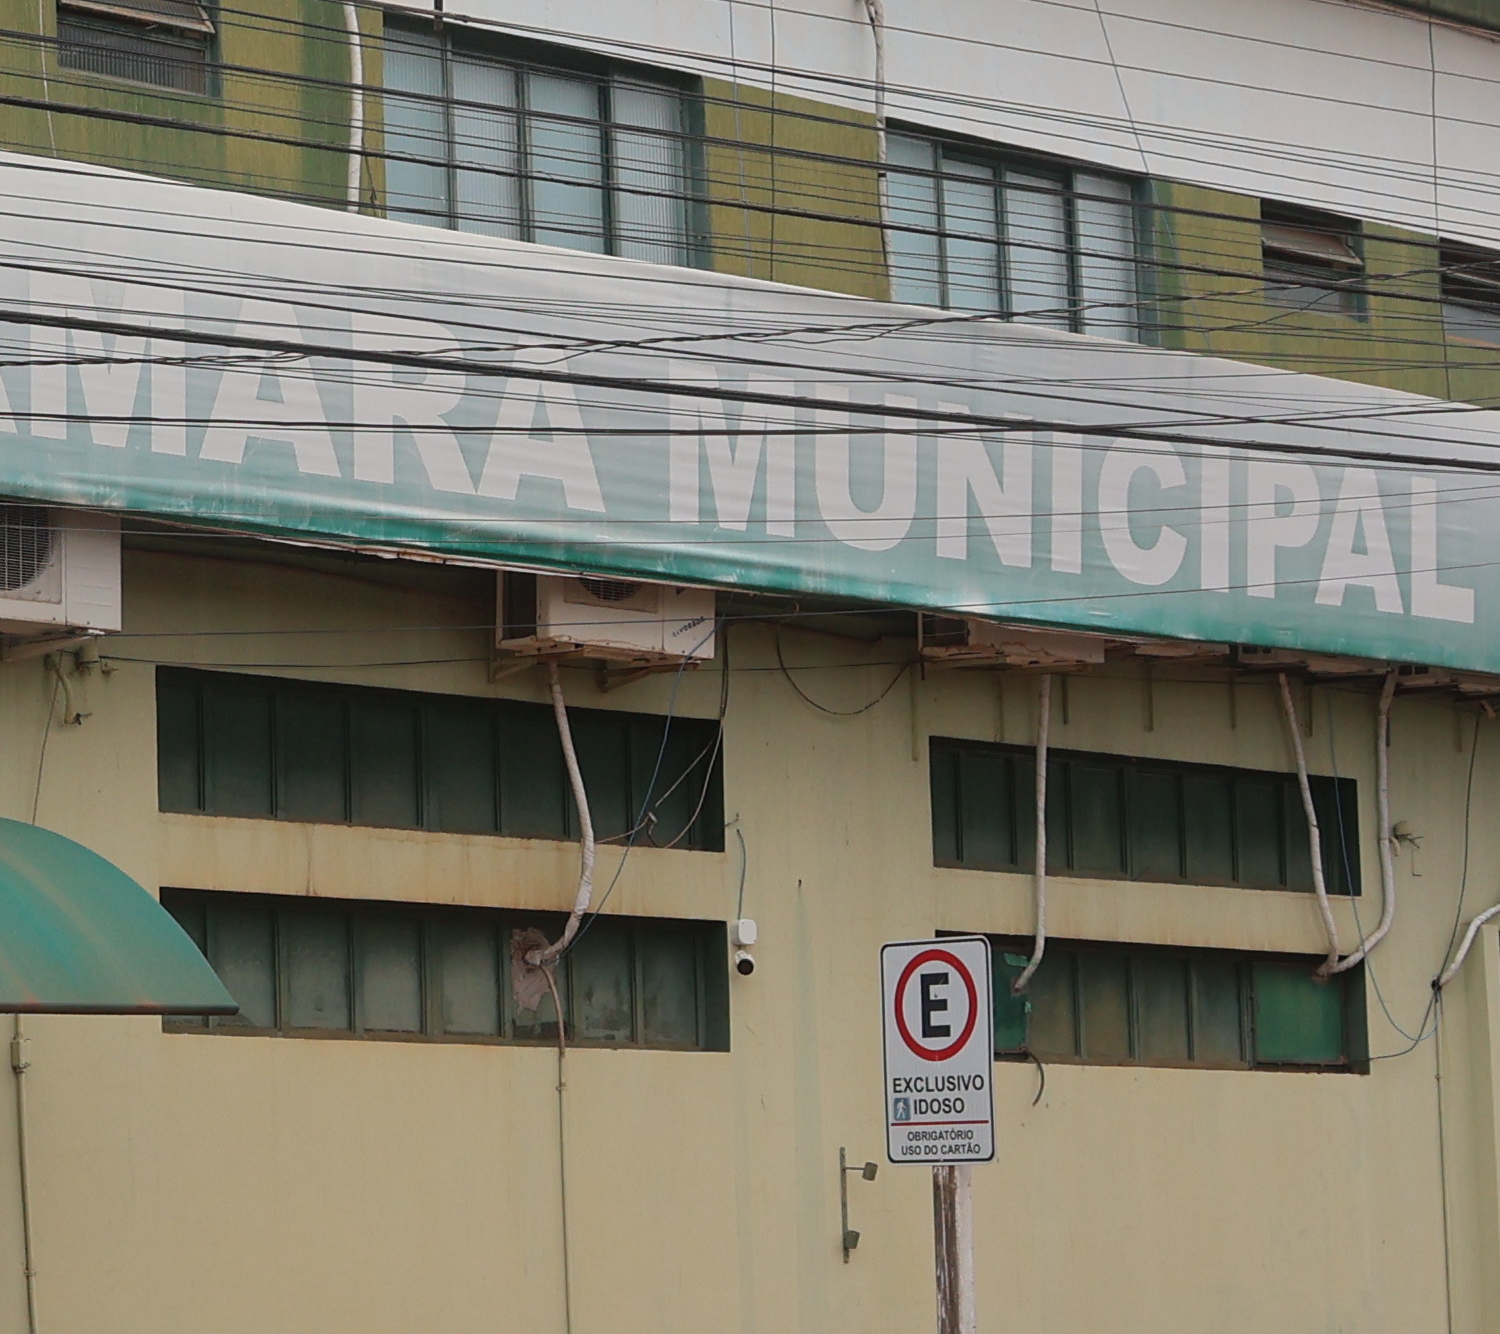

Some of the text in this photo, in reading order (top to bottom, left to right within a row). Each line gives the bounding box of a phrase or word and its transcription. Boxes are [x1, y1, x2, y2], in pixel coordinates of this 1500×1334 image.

[667, 358, 1475, 624] MUNICIPAL
[919, 971, 952, 1039] E
[892, 1074, 985, 1094] EXCLUSIVO
[913, 1097, 965, 1115] IDOSO
[906, 1128, 974, 1142] OBRIGATÓRIO
[901, 1141, 981, 1156] USO DO CARTÃO
